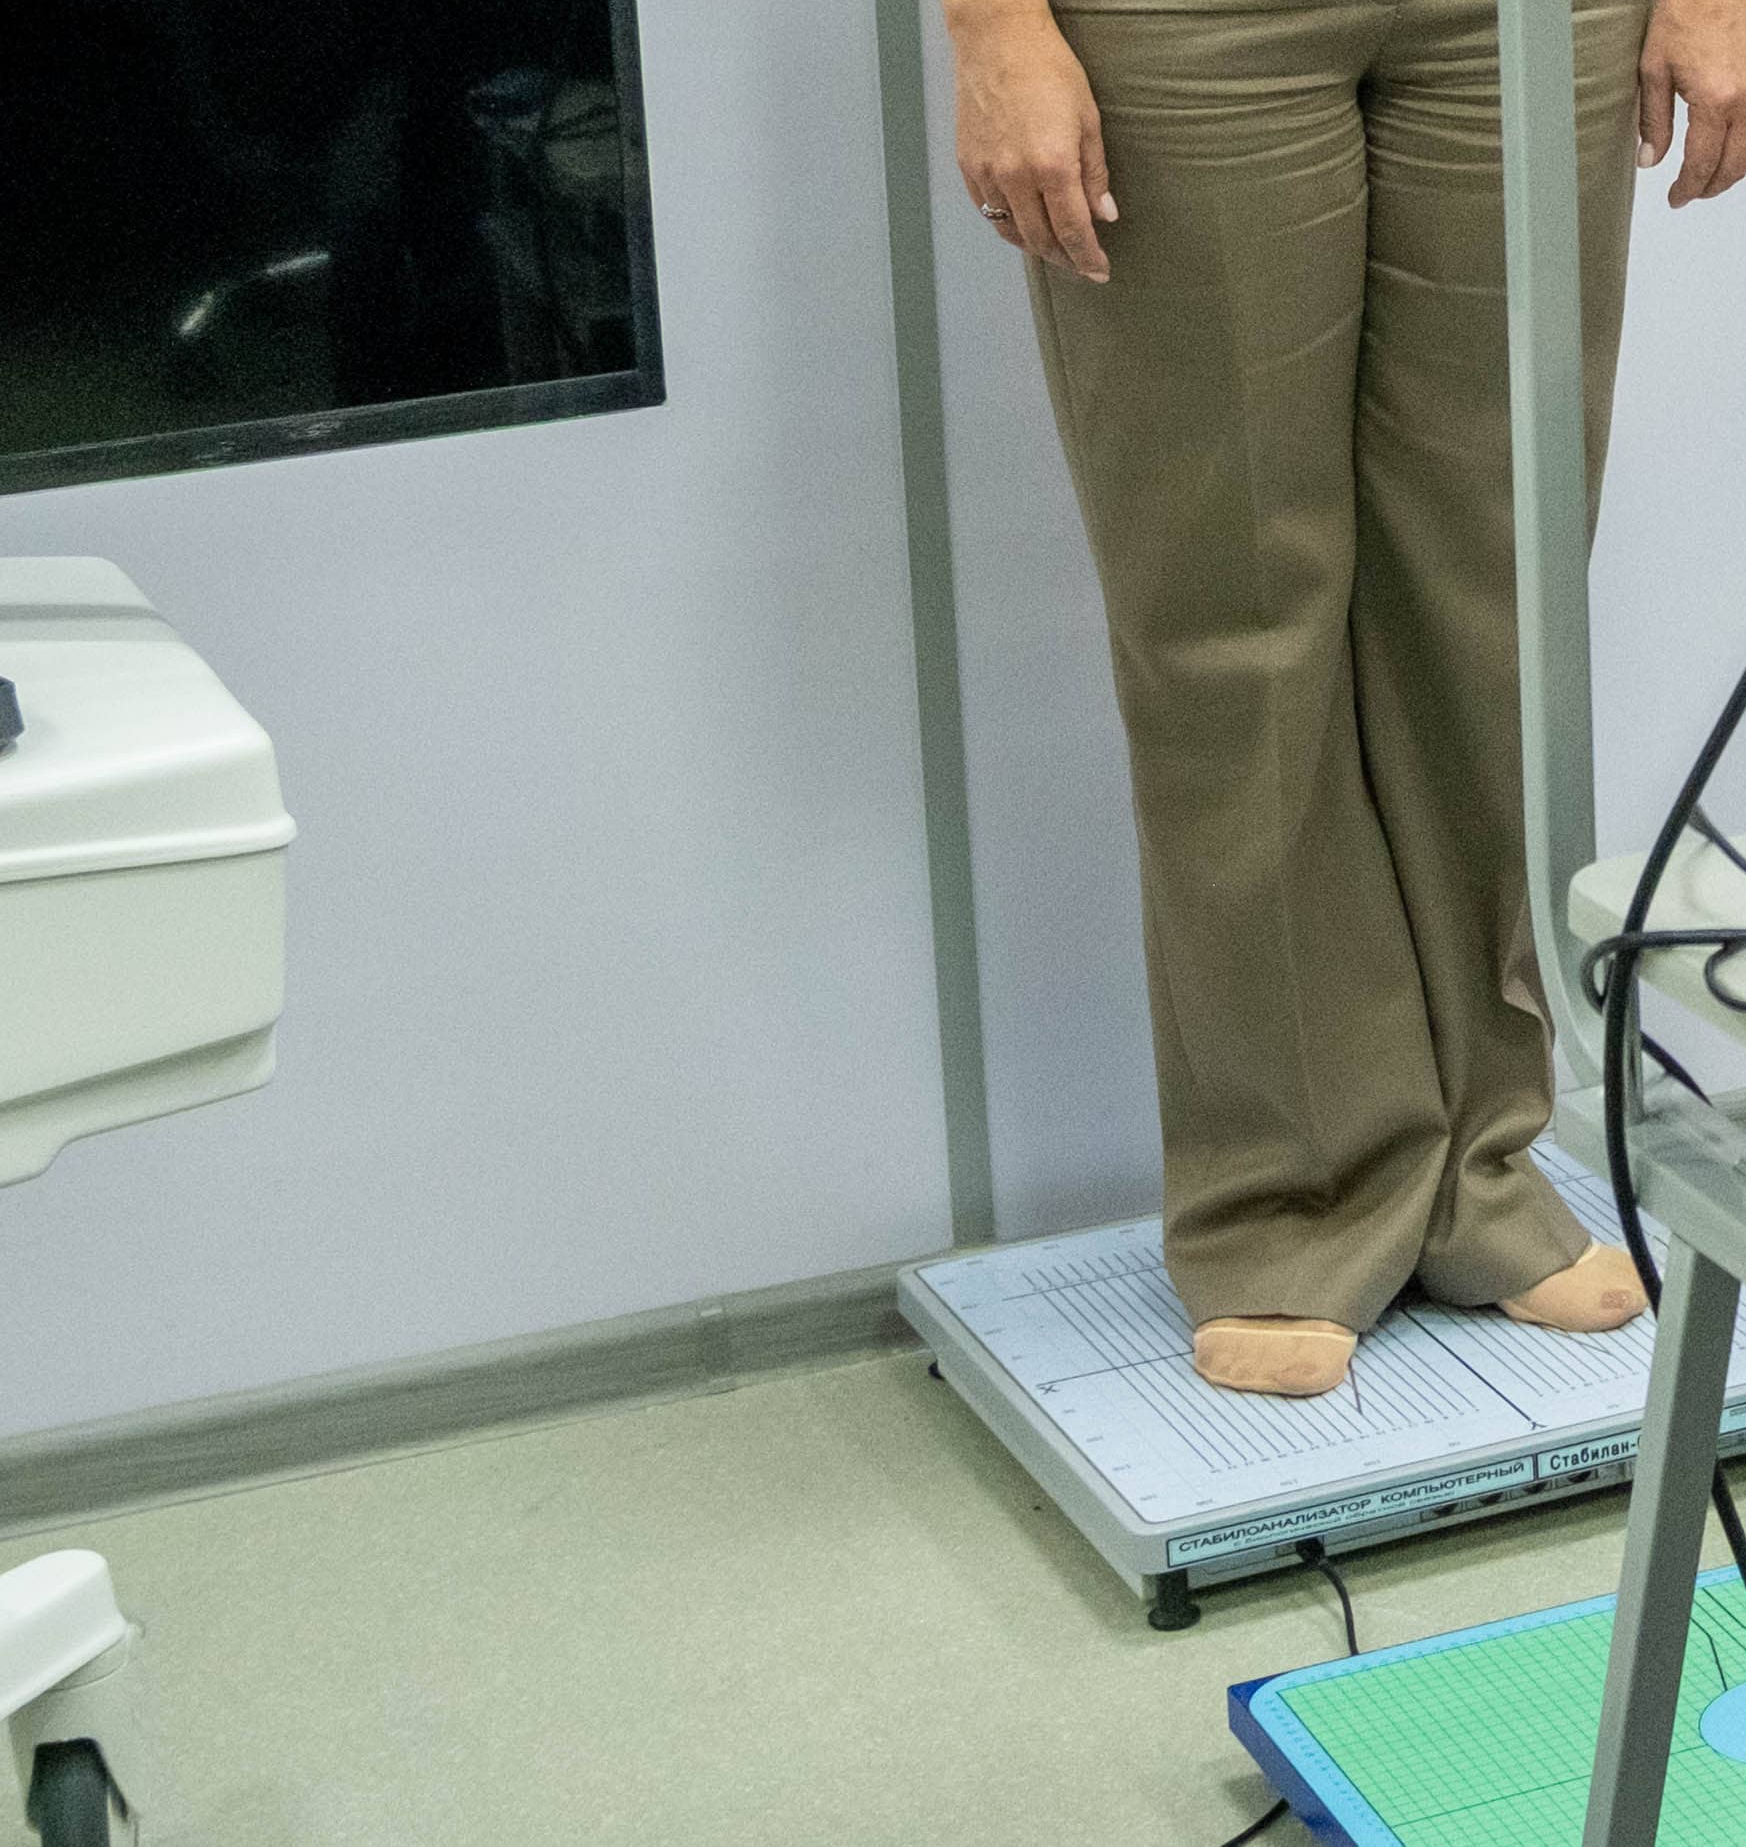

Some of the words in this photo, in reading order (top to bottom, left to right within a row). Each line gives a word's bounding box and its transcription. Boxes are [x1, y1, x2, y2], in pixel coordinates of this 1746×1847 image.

[1550, 1434, 1641, 1471] Стабилан-
[1178, 1499, 1372, 1553] СТАБИЛОАНАЛИЗАТОР
[1380, 1461, 1525, 1505] КОМПЬЮТЕРНЫЙ
